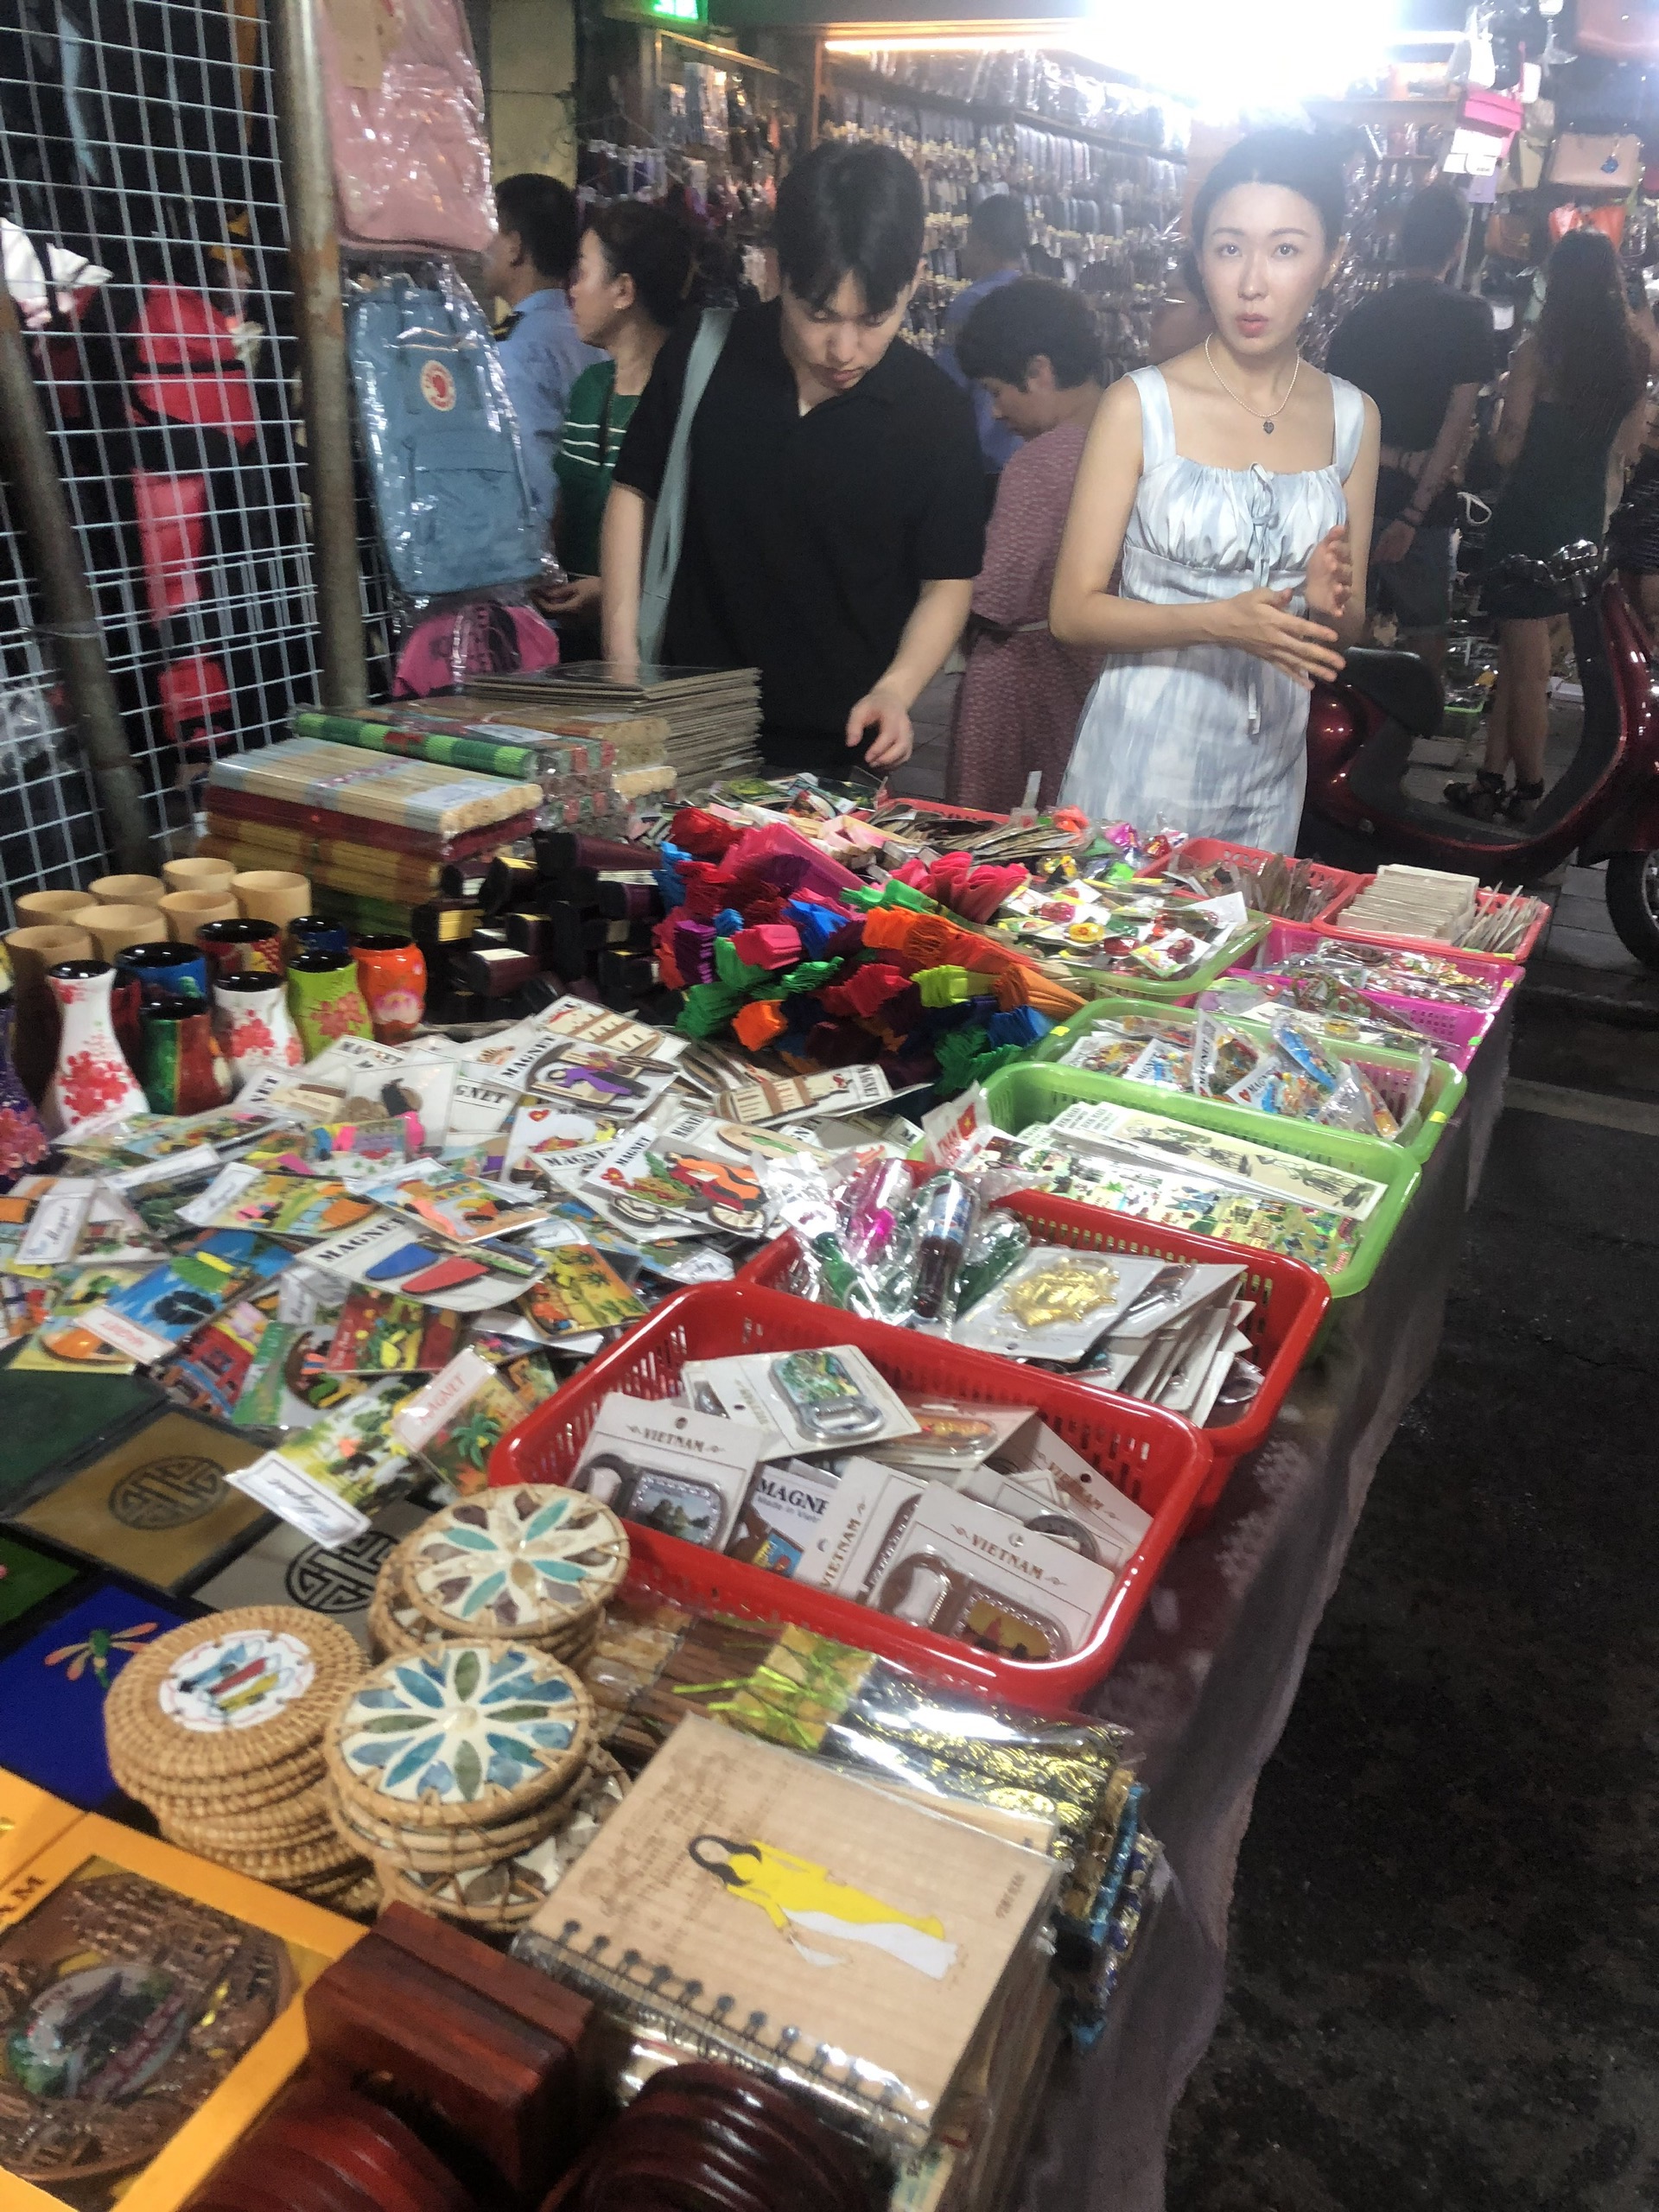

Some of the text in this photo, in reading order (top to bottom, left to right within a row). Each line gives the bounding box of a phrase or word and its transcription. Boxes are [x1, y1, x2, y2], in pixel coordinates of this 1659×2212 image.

[501, 1035, 556, 1079] MAGNET
[615, 1135, 652, 1167] MAGNET
[644, 1427, 705, 1452] VIETNAM
[756, 1478, 830, 1515] MAGNE
[822, 1518, 861, 1587] VIETNAM
[970, 1534, 1044, 1580] VIETNAM
